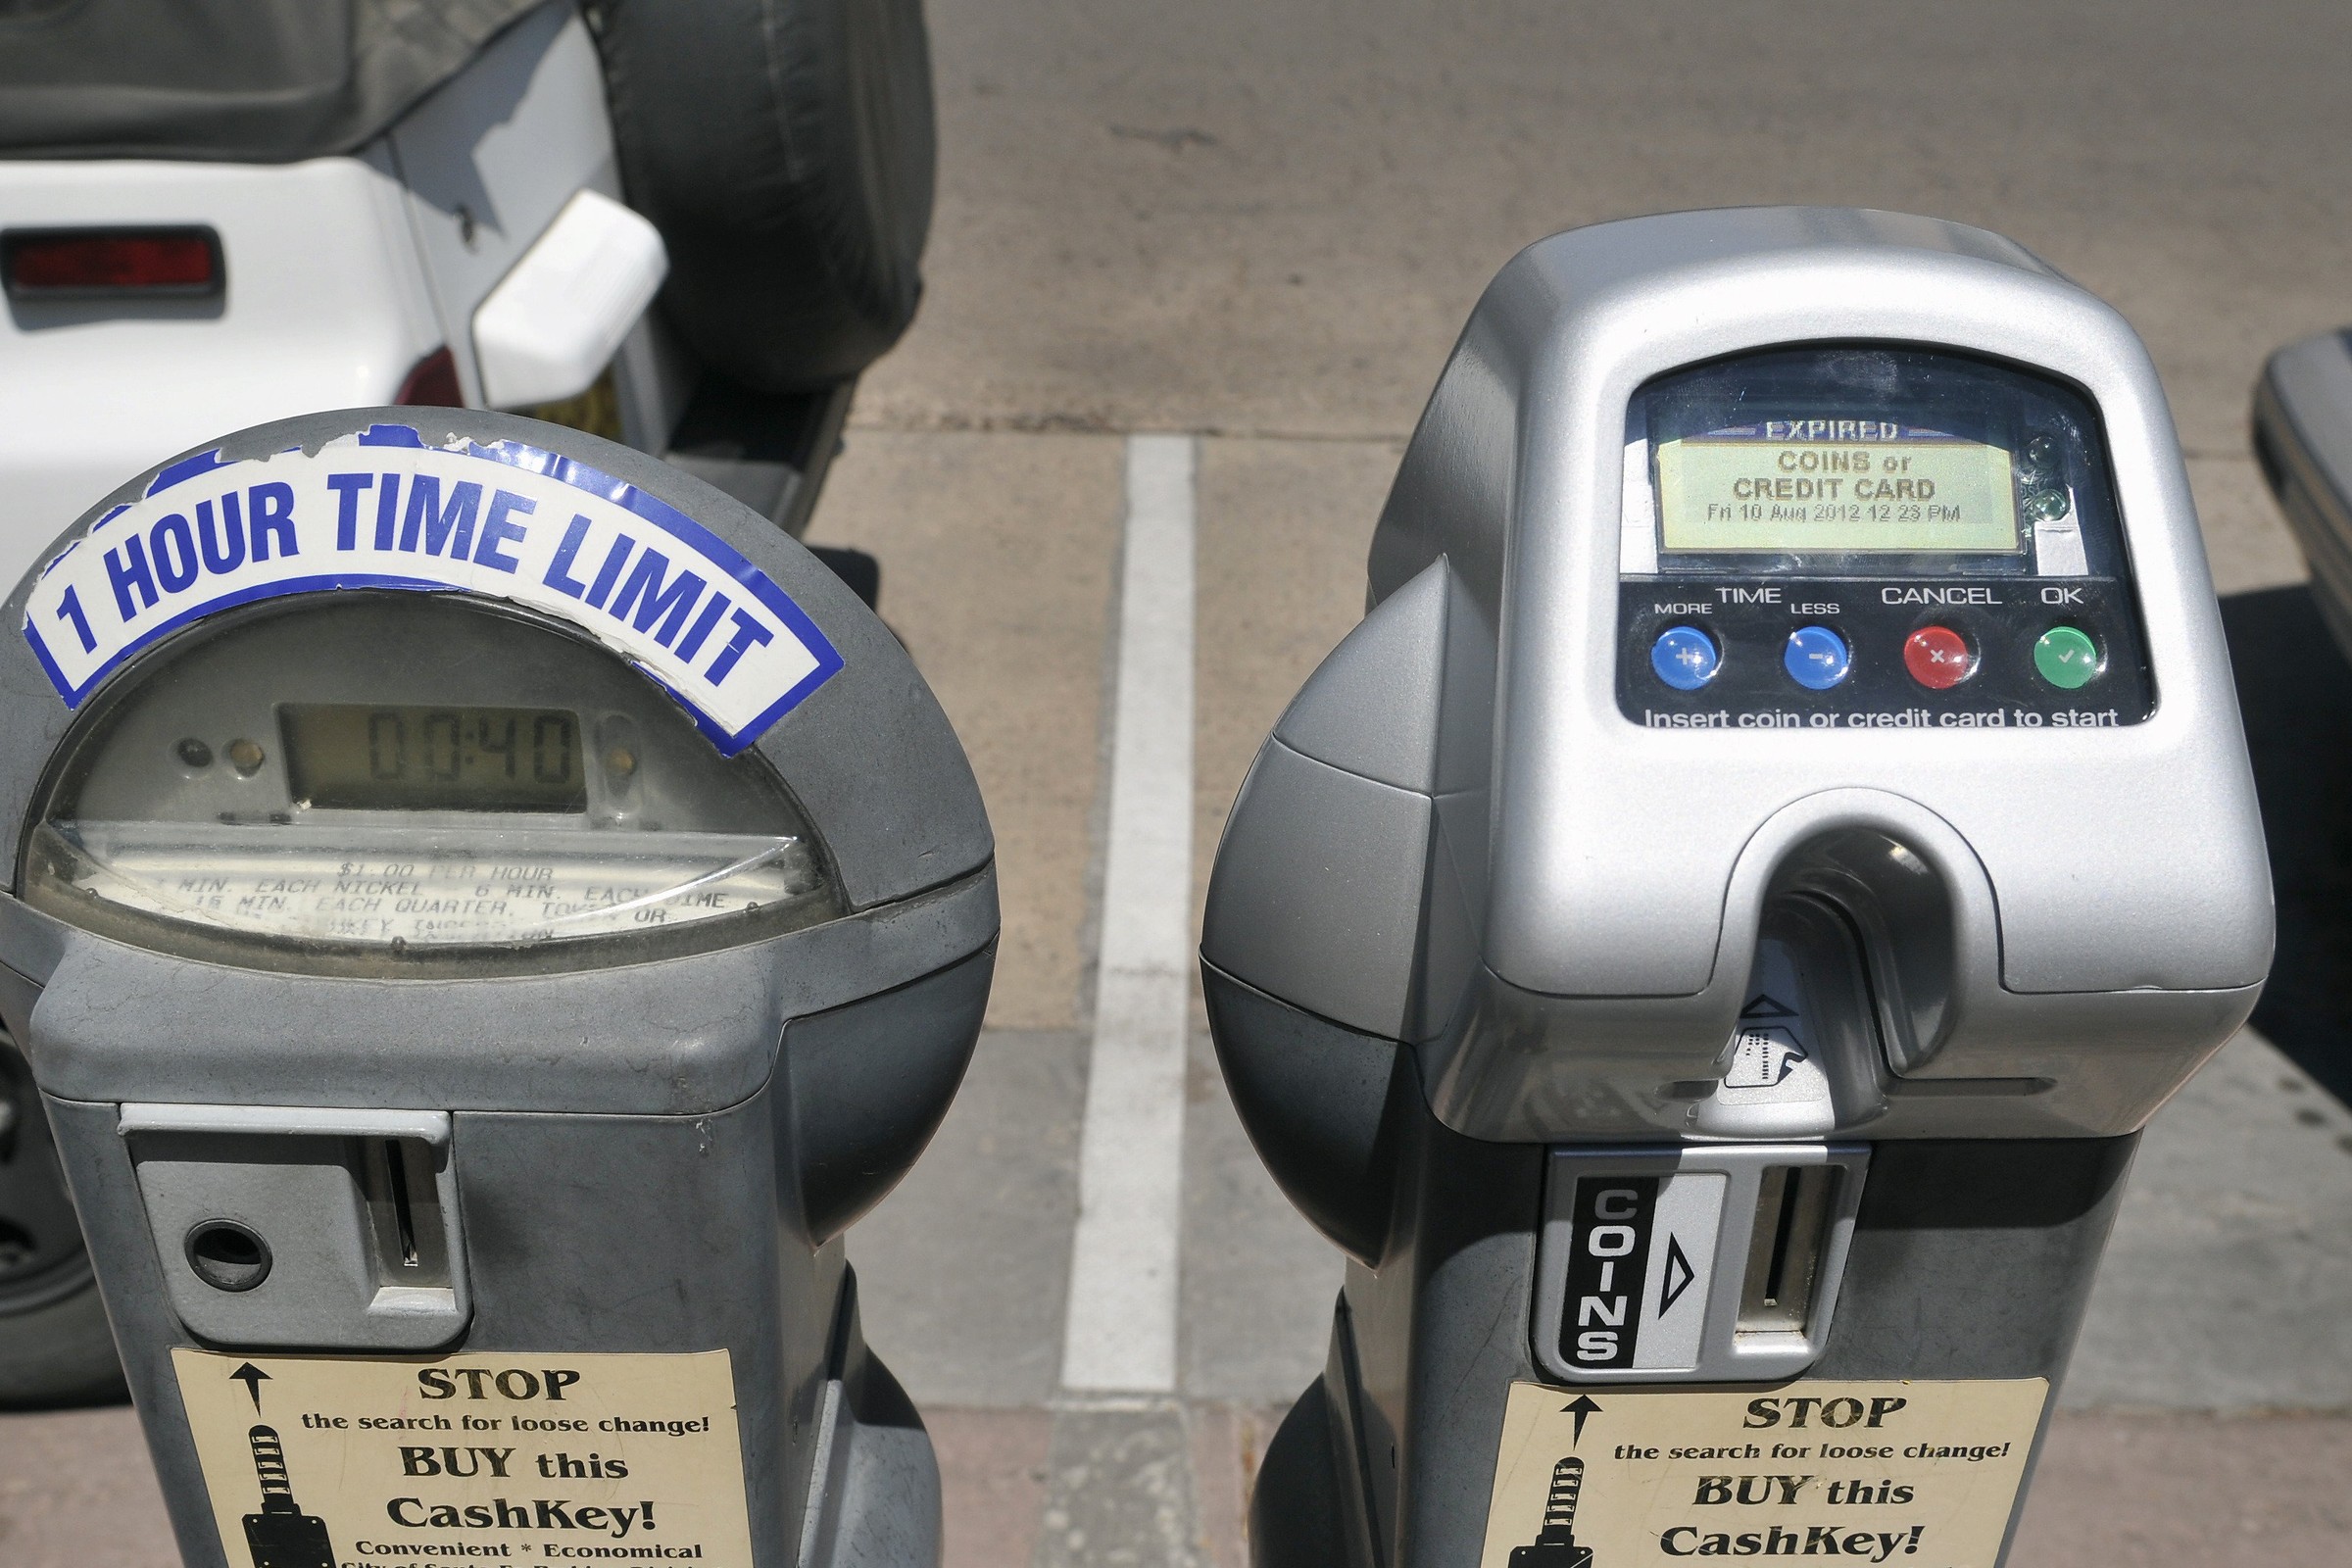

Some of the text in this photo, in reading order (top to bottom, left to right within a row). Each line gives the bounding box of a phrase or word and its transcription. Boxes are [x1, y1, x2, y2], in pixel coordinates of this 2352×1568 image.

[1766, 420, 1897, 441] EXPIRED
[1778, 451, 1912, 473] COINS or
[1733, 478, 1936, 501] CREDIT CARD
[1707, 504, 1732, 521] Fri
[1740, 504, 1762, 521] 10
[1770, 504, 1807, 523] Aug
[1813, 505, 1860, 521] 2012
[1927, 505, 1961, 522] PM
[56, 472, 774, 686] 1 HOUR TIME LIMIT
[1715, 588, 1782, 604] TIME
[1882, 588, 2002, 605] CANCEL
[2040, 588, 2083, 605] OK
[1654, 604, 1712, 614] MORE
[1790, 604, 1840, 615] LESS
[1645, 709, 2119, 728] Insert coin or credit card to start
[368, 712, 571, 783] 00:40
[490, 866, 553, 880] HOUR
[255, 878, 321, 893] EACH
[334, 881, 423, 895] NICKEL
[507, 885, 561, 899] MIN.
[316, 897, 382, 911] EACH
[634, 908, 667, 923] OR
[1577, 1190, 1638, 1360] COINS
[418, 1368, 580, 1400] STOP
[1742, 1397, 1907, 1429] STOP
[302, 1413, 710, 1437] the search for loose change!
[400, 1446, 629, 1479] BUY this
[1614, 1442, 2010, 1463] the search for loose change!
[1692, 1475, 1914, 1505] BUY this
[386, 1497, 656, 1537] CashKey!
[356, 1541, 703, 1558] Convenient Economical
[1660, 1526, 1926, 1563] CashKey!
